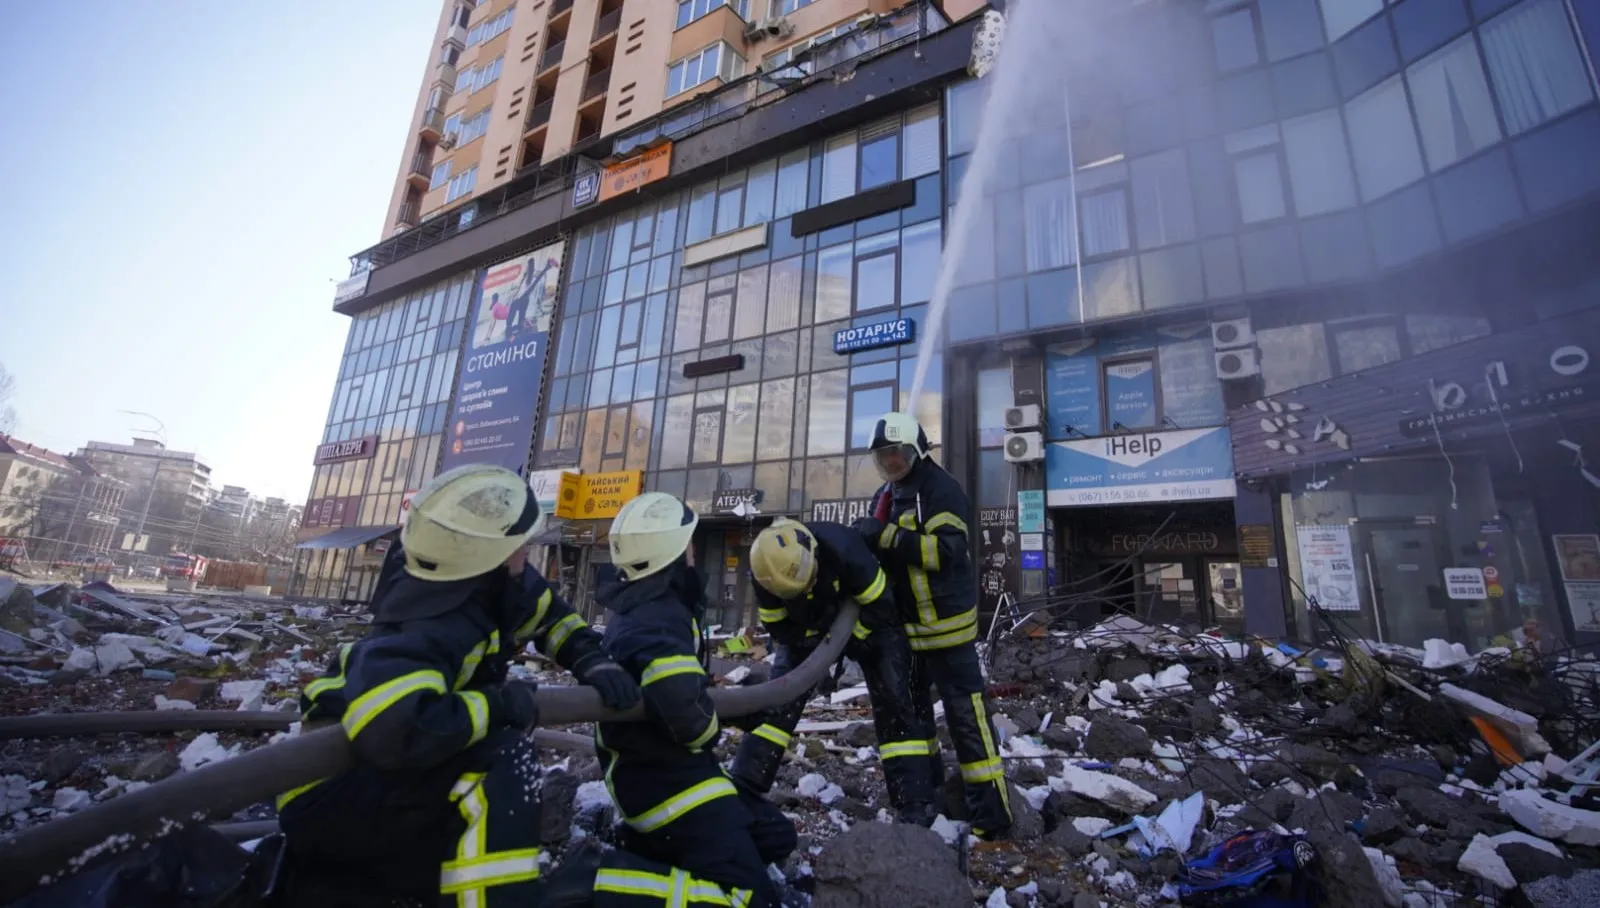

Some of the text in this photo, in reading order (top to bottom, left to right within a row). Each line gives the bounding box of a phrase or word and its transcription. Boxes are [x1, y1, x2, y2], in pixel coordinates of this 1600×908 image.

[837, 319, 906, 343] НОТАРІУС
[1118, 391, 1143, 400] Apple
[1115, 401, 1148, 410] Service
[320, 439, 364, 459] ШПАЛЕРИ
[1105, 435, 1162, 457] iHelp
[586, 475, 629, 486] ТАЙСЬКИЙ
[1069, 466, 1214, 485] ремонт сервіс аксесуари
[591, 486, 621, 495] МАСАЖ
[980, 509, 1015, 521] COZY BAR
[1112, 531, 1219, 552] FORWARD
